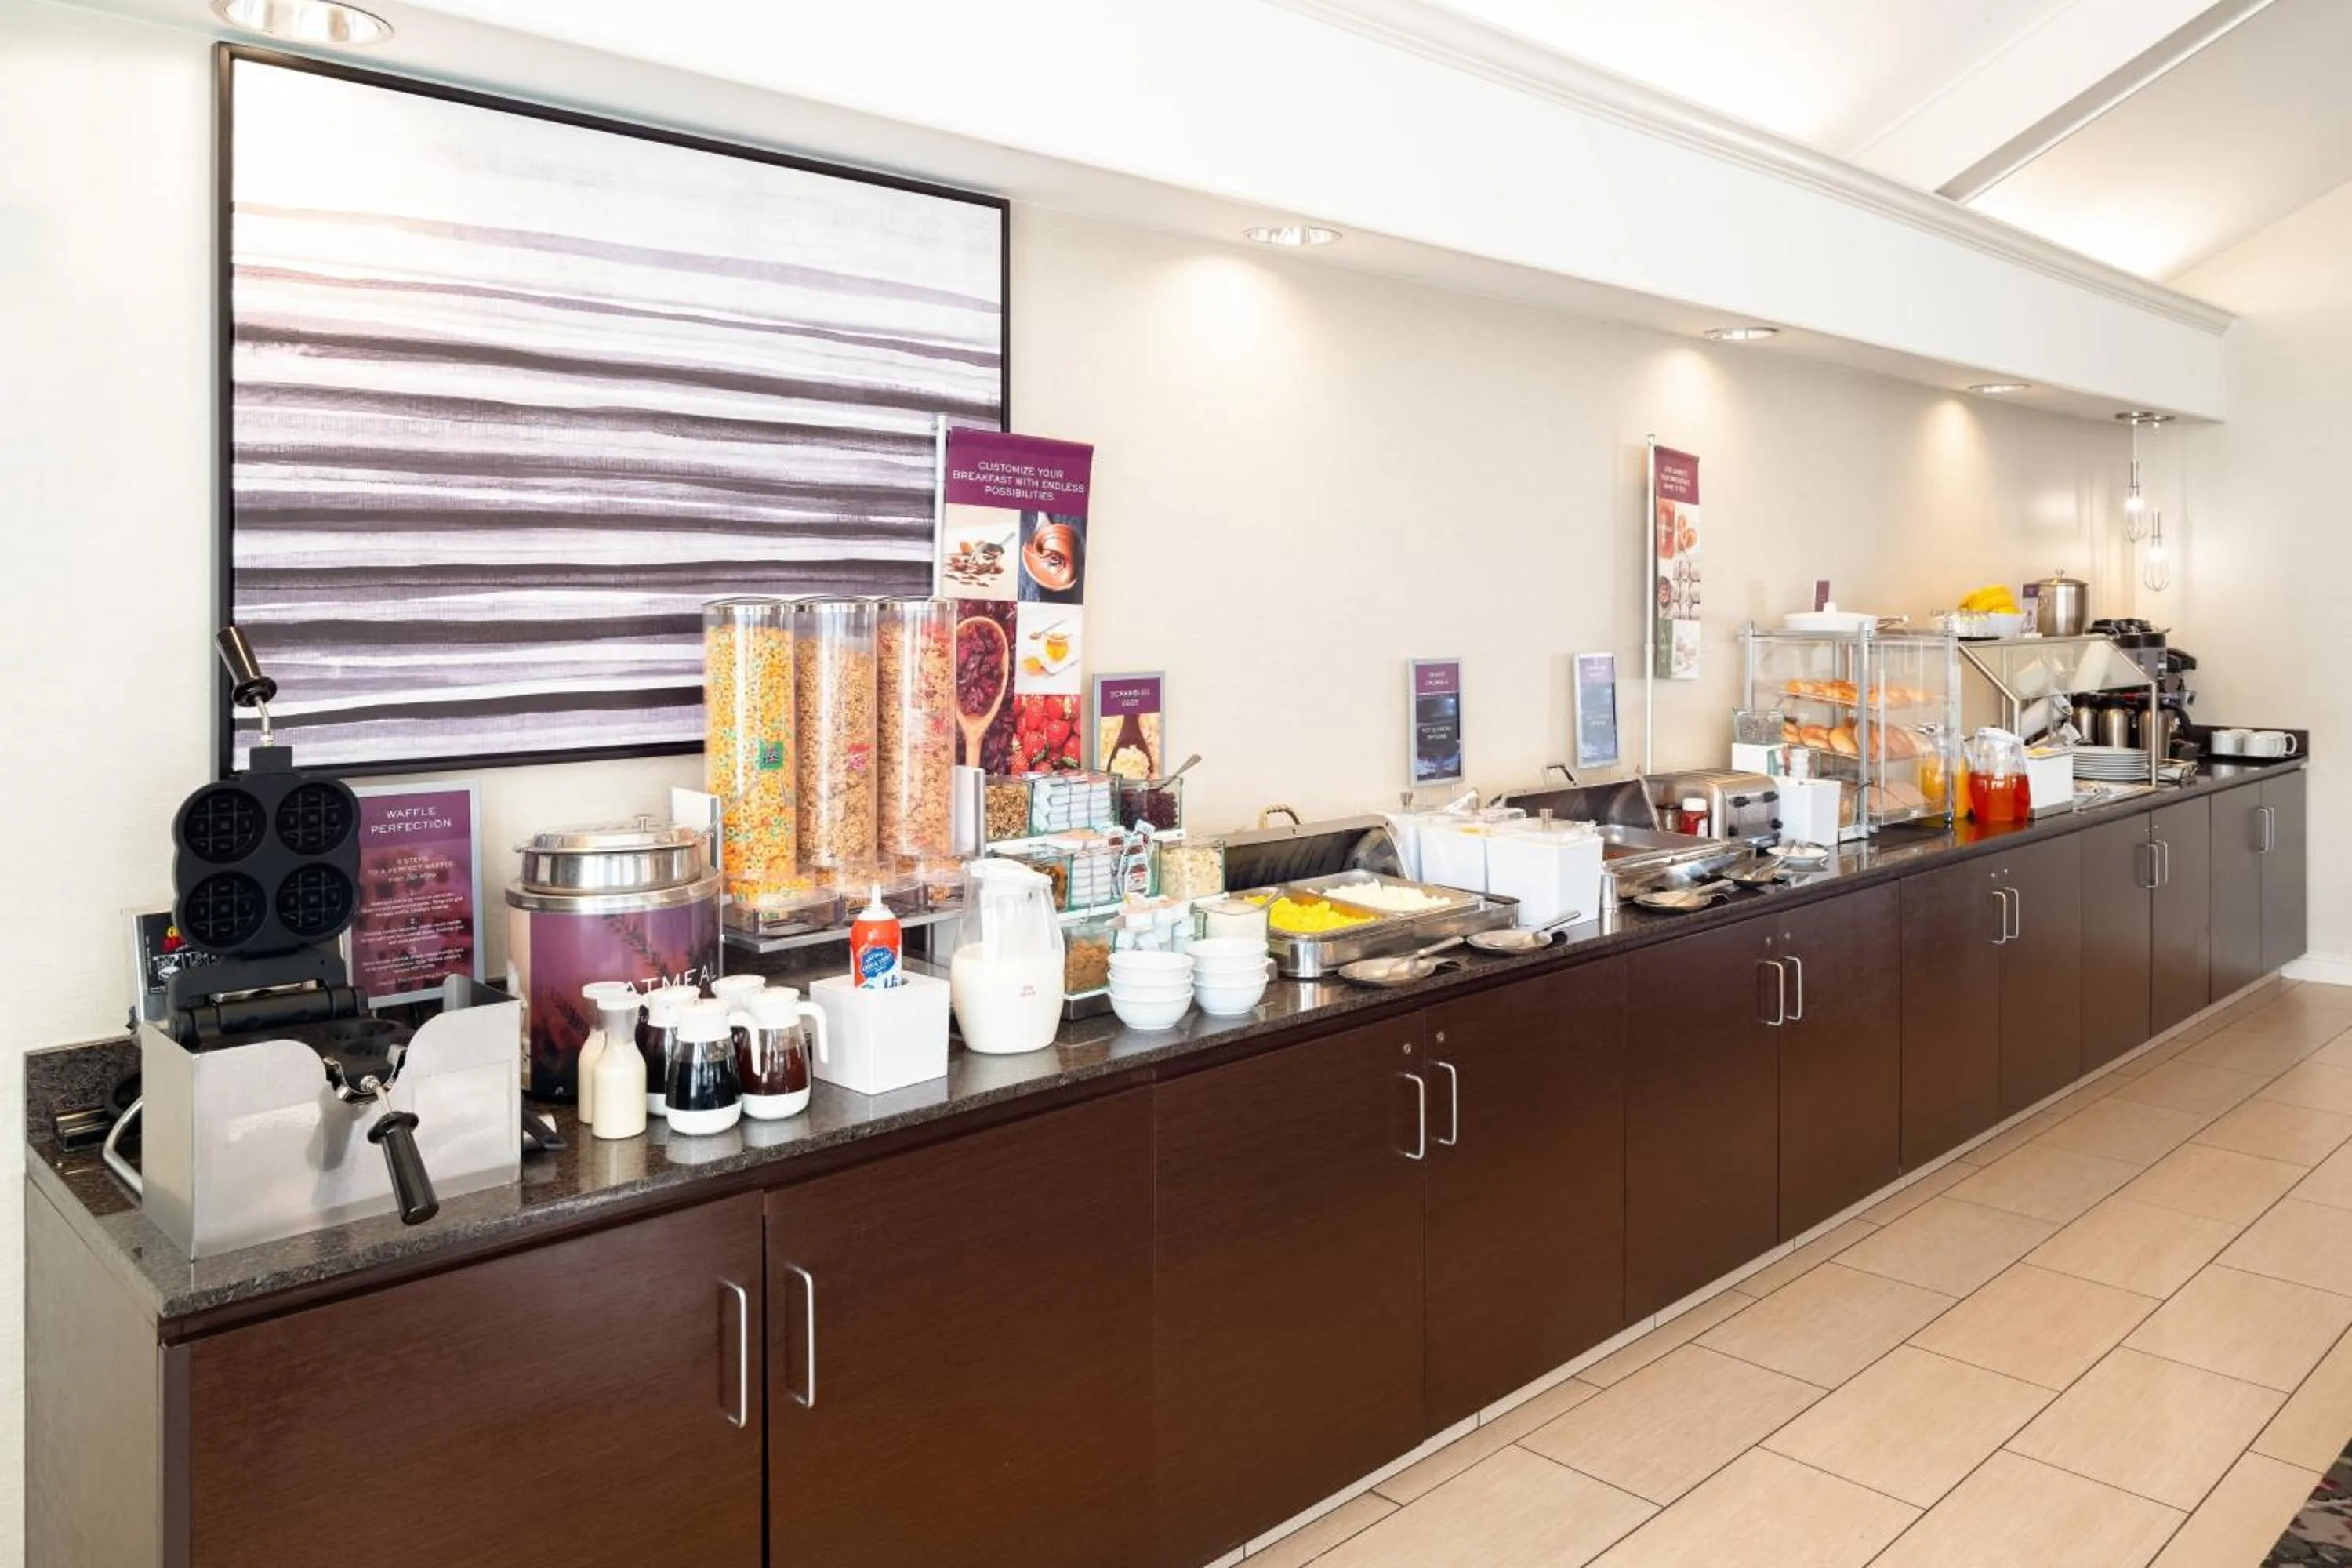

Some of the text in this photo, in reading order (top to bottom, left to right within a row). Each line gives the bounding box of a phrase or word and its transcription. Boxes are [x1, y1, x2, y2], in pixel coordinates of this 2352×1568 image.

[978, 460, 1064, 479] CUSTOMIZE YOUR
[953, 470, 1085, 493] BREAKFAST WITH ENDLESS
[386, 806, 437, 819] WAFFLE
[371, 818, 452, 835] PERFECTION
[626, 960, 717, 995] ATMEAL
